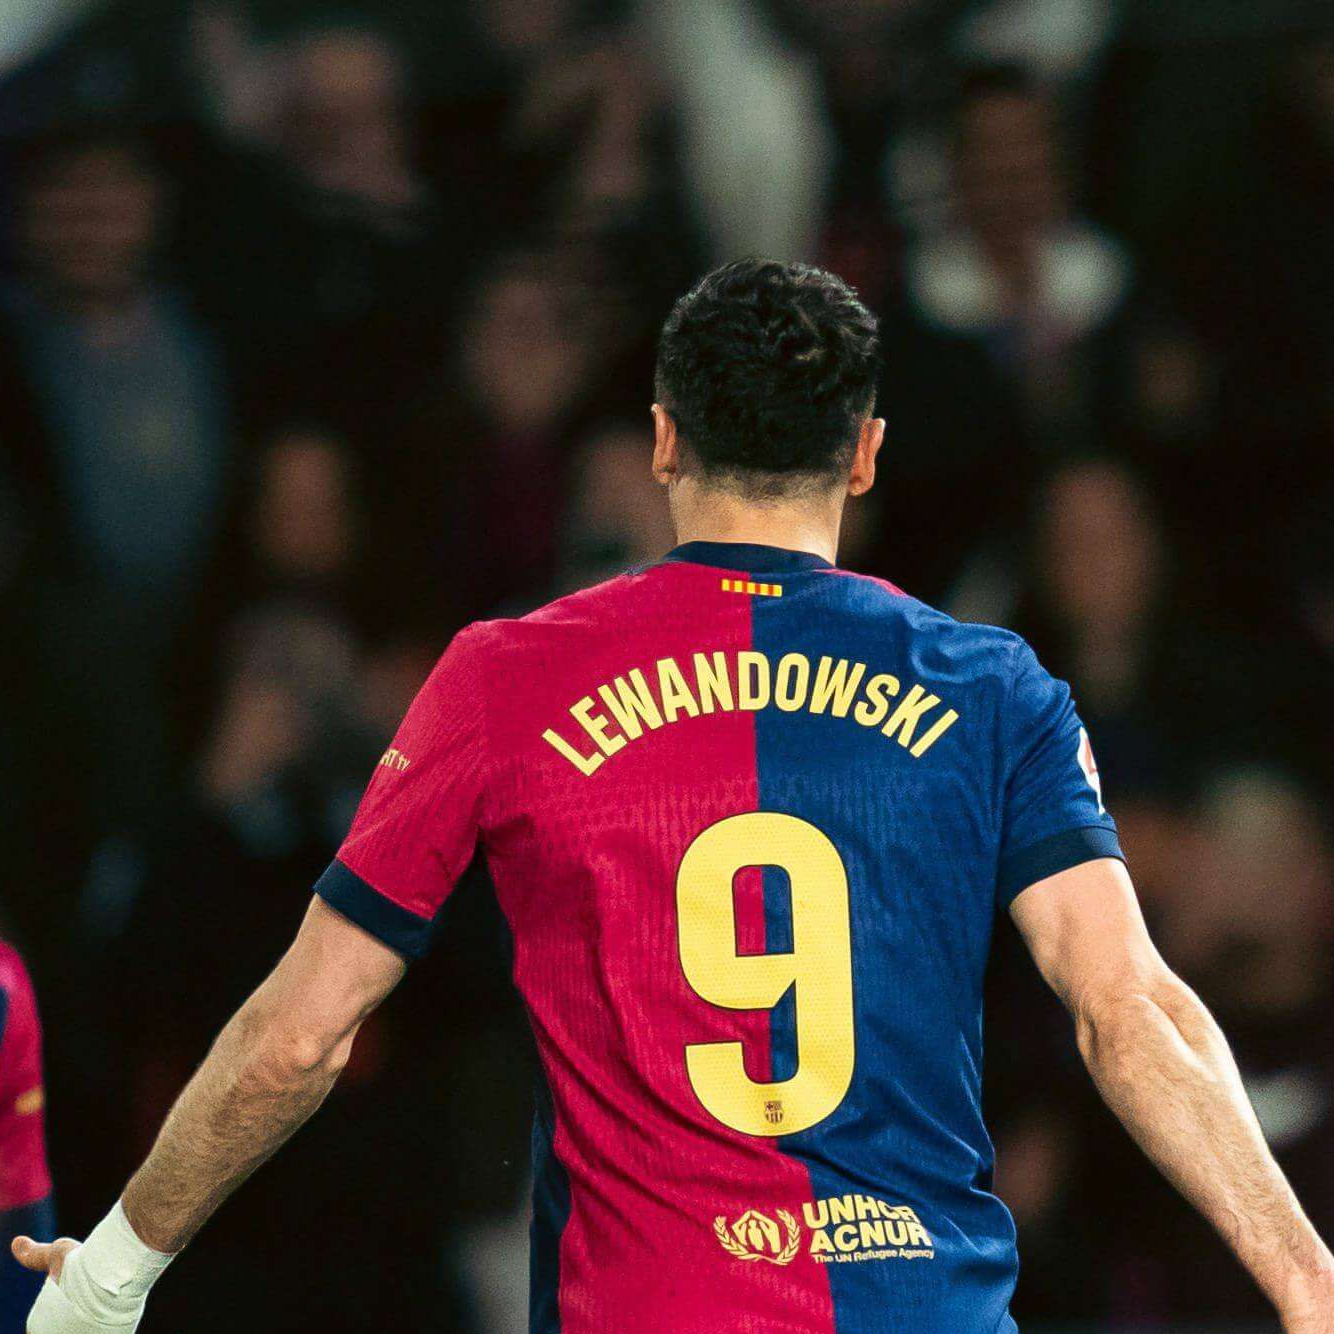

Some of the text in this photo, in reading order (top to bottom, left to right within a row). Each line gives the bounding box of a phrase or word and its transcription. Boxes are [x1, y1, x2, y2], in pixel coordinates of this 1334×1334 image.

[541, 650, 960, 777] LEWANDOWSKI
[675, 811, 856, 1137] 9
[809, 1219, 933, 1254] ACNUR
[813, 1247, 935, 1264] The UN Refugee Agency
